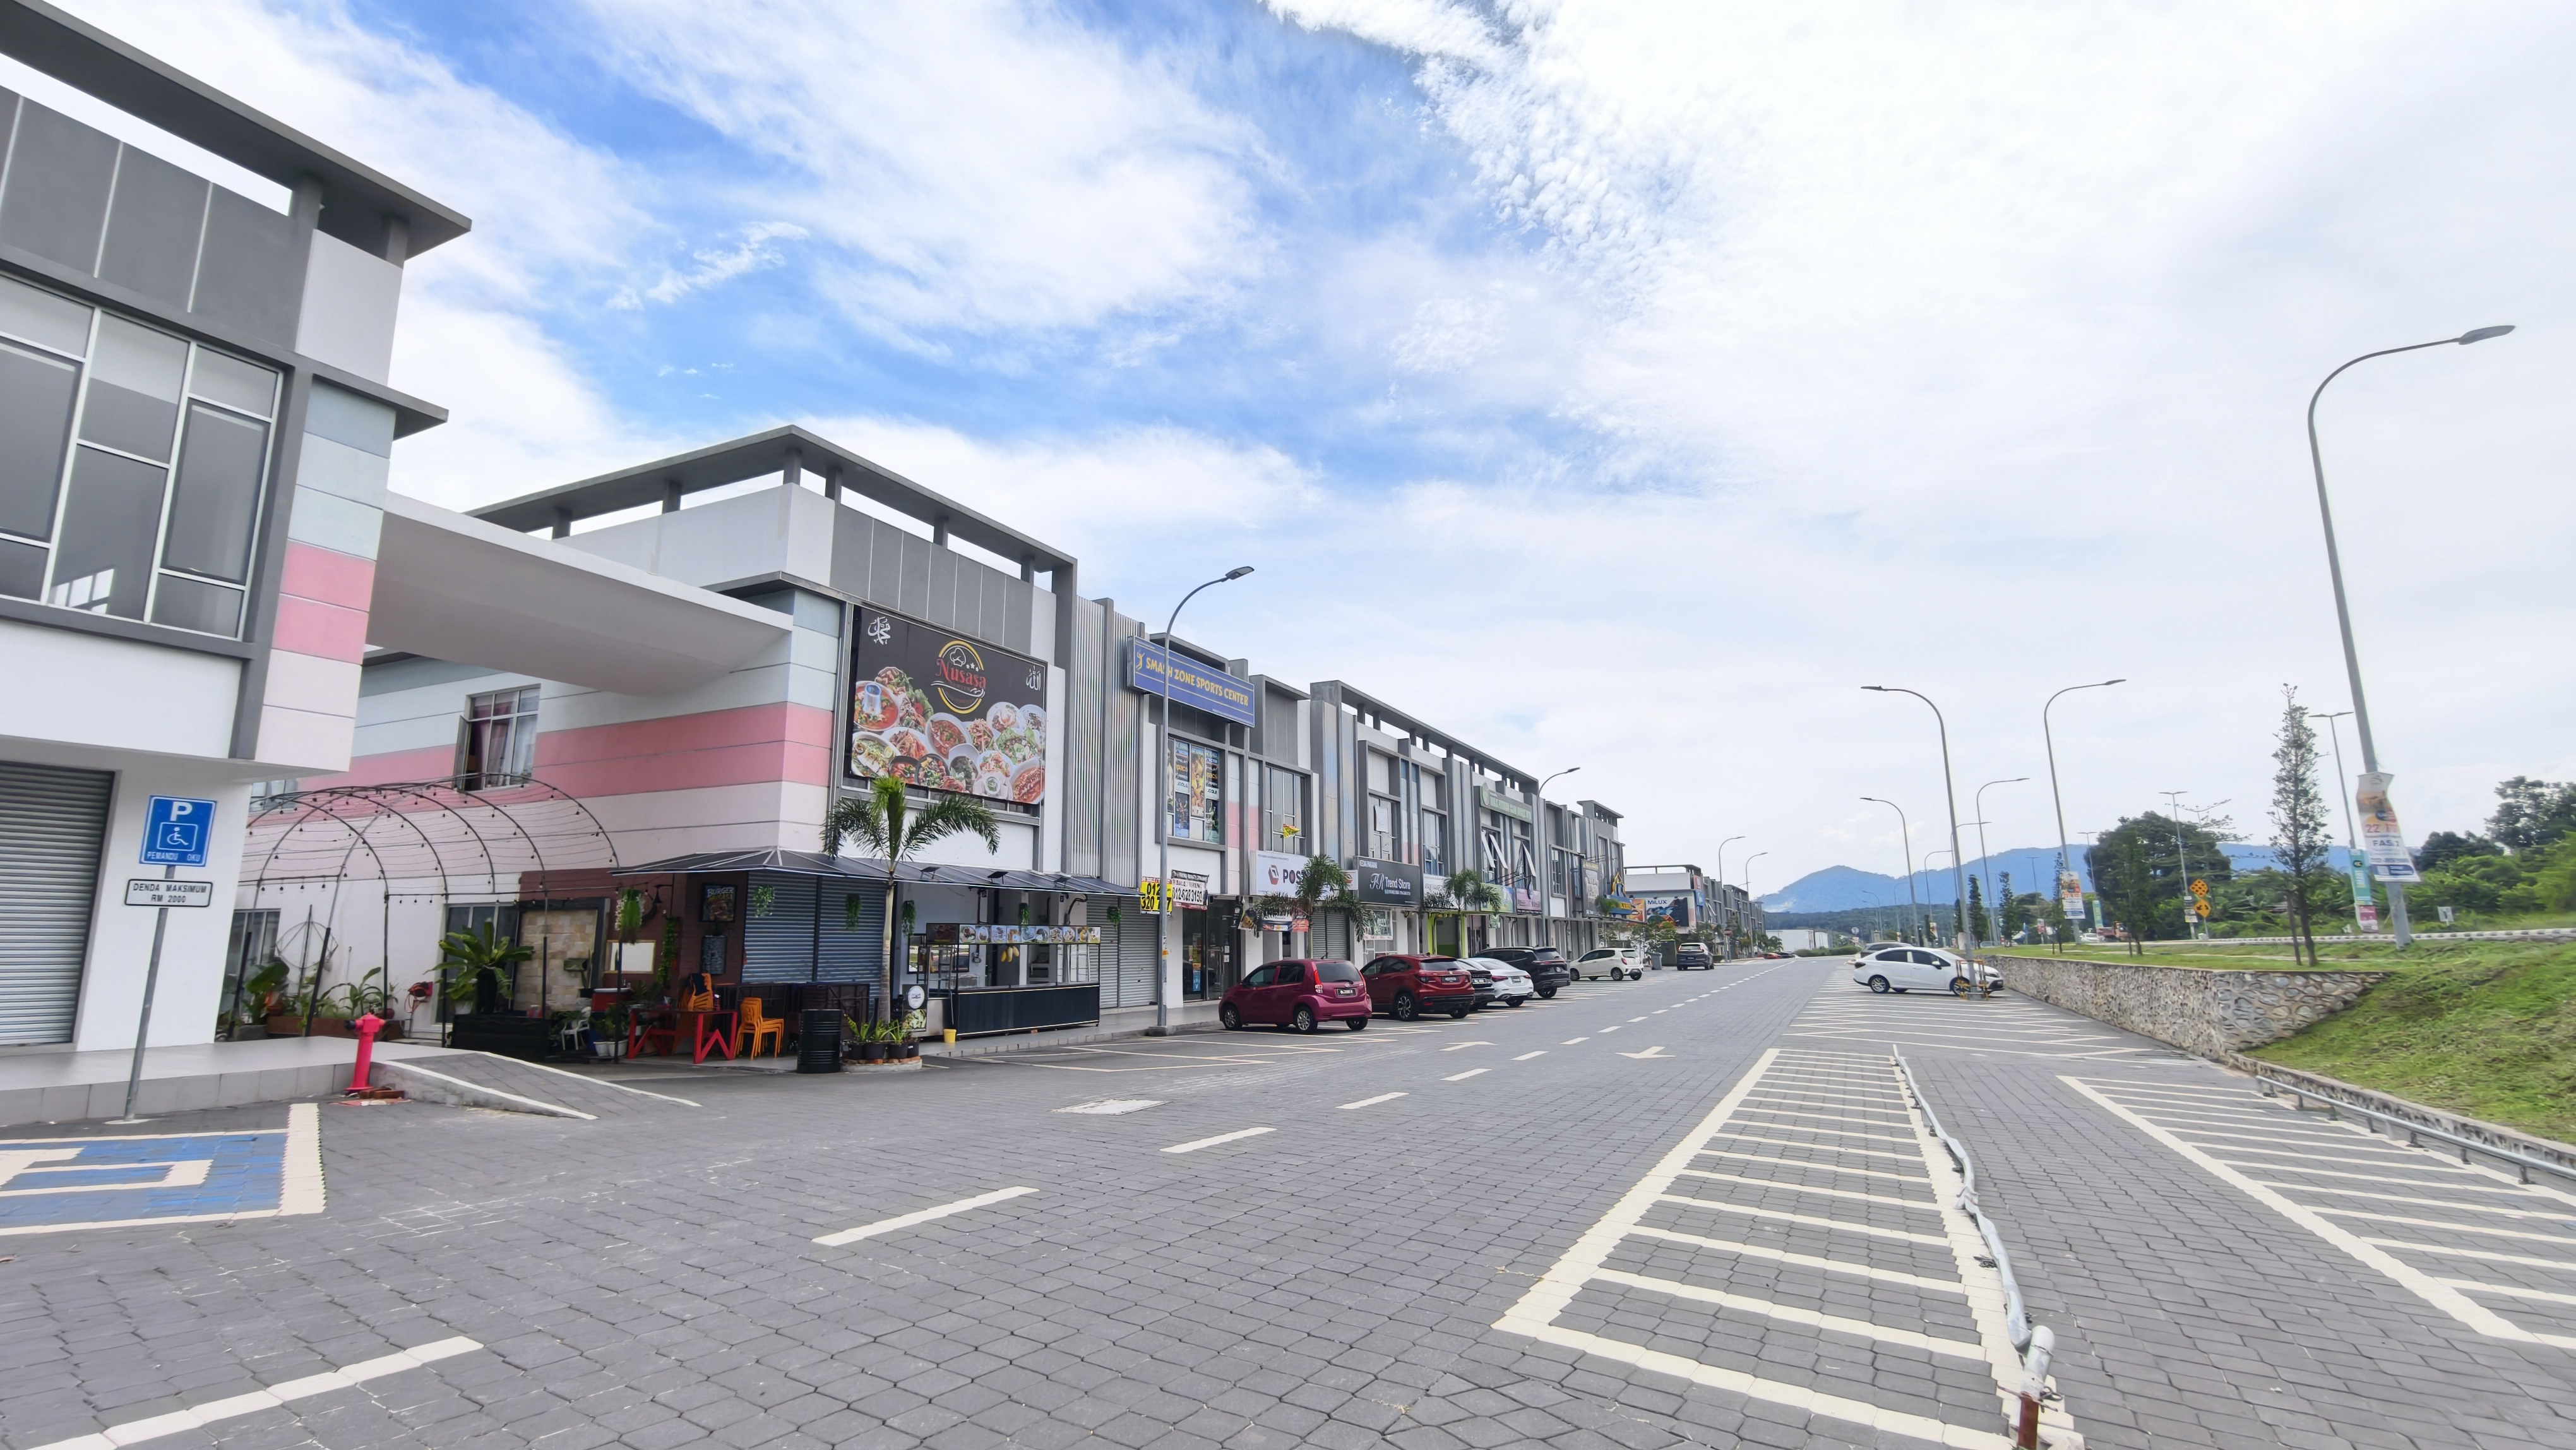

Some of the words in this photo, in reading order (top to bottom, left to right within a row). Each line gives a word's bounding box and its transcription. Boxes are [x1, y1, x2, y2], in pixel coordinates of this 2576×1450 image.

[935, 658, 987, 689] Nusasa
[1146, 657, 1173, 678] SMAH
[1174, 669, 1195, 685] ZONE
[1196, 676, 1223, 697] SPORTS
[1224, 688, 1248, 706] CENTER
[169, 800, 193, 822] P
[146, 851, 179, 861] PEMANDU
[187, 853, 201, 862] OKU
[133, 883, 160, 892] DENDA
[165, 884, 207, 894] MAKSIMUM
[1385, 877, 1398, 889] Trend
[1398, 878, 1410, 890] Store
[150, 894, 164, 903] RM
[167, 894, 186, 903] 2000
[1141, 896, 1155, 909] 320
